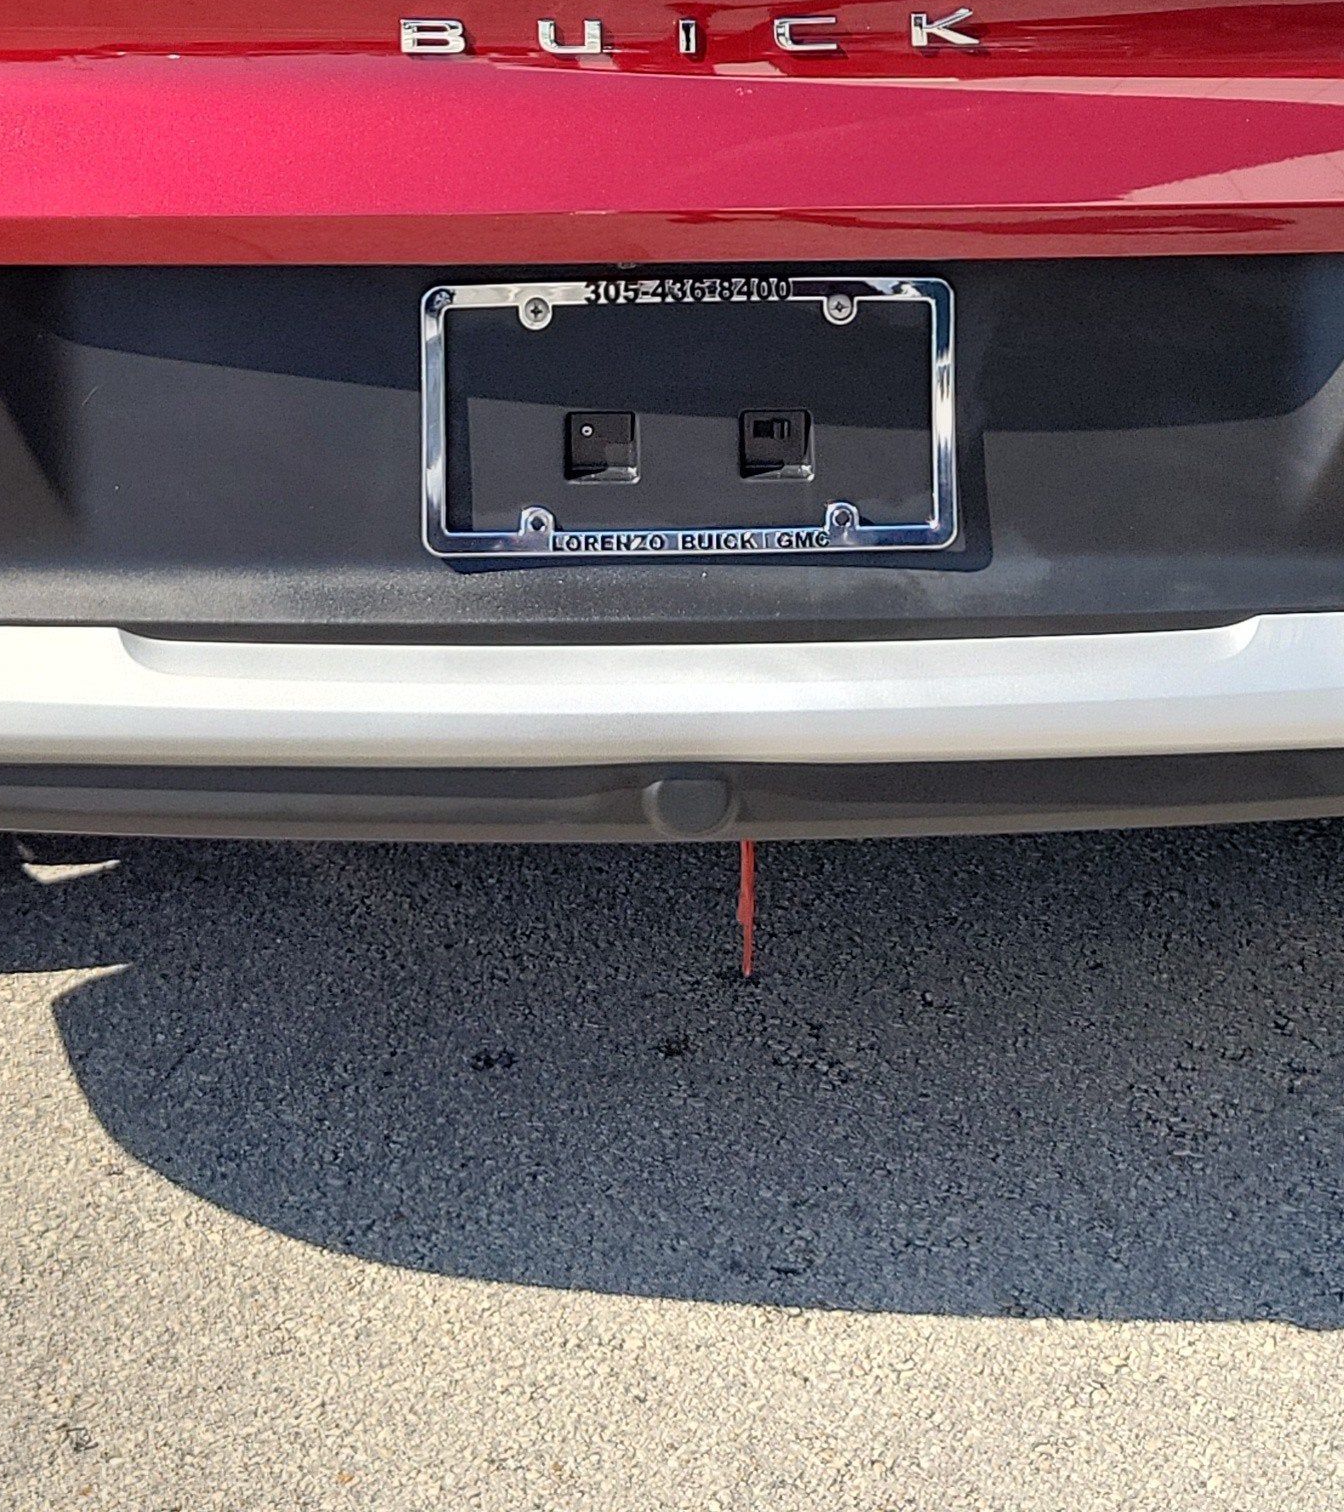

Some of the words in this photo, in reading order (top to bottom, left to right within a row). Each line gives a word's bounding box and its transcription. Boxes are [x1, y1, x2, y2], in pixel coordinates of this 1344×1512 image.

[399, 7, 981, 54] BUICK
[584, 278, 793, 305] 305-436-8400
[553, 531, 666, 552] LORENZO
[680, 531, 758, 551] BUICK
[776, 530, 830, 548] GMC
